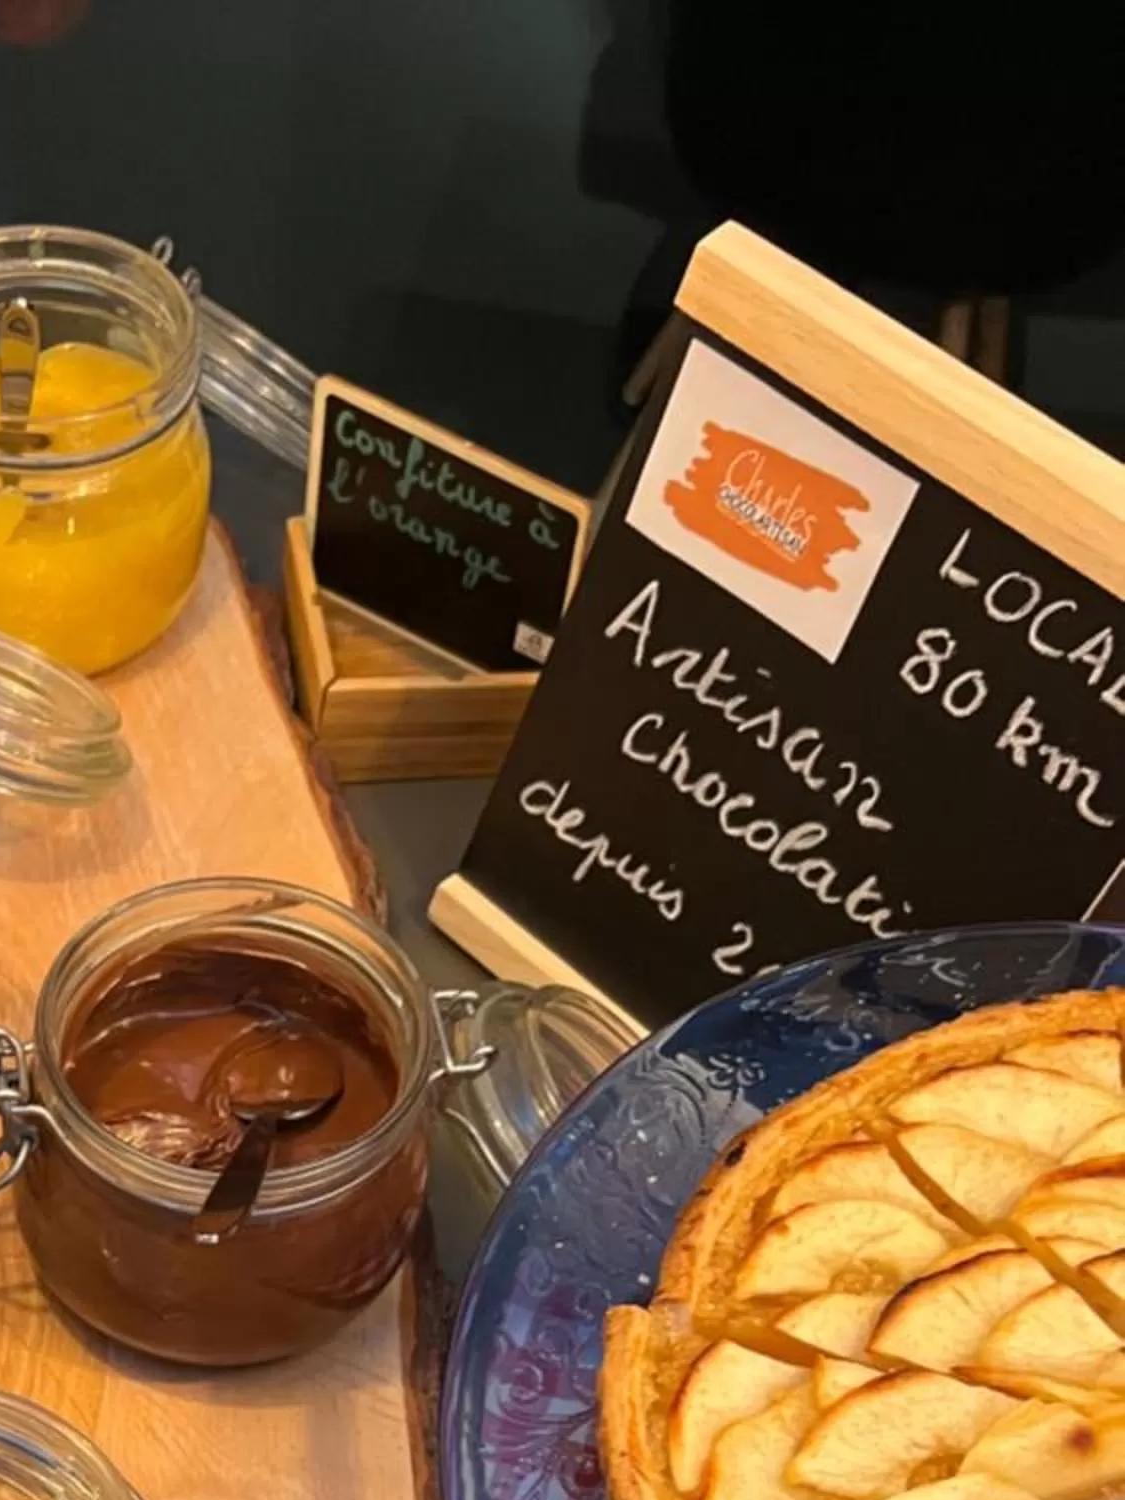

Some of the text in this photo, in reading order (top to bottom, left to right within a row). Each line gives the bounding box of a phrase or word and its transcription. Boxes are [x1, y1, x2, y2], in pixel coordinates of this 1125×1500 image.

[334, 409, 512, 528] Confiture
[604, 579, 893, 832] Artisan
[898, 626, 1113, 828] 80 km
[520, 779, 780, 977] depuis 2
